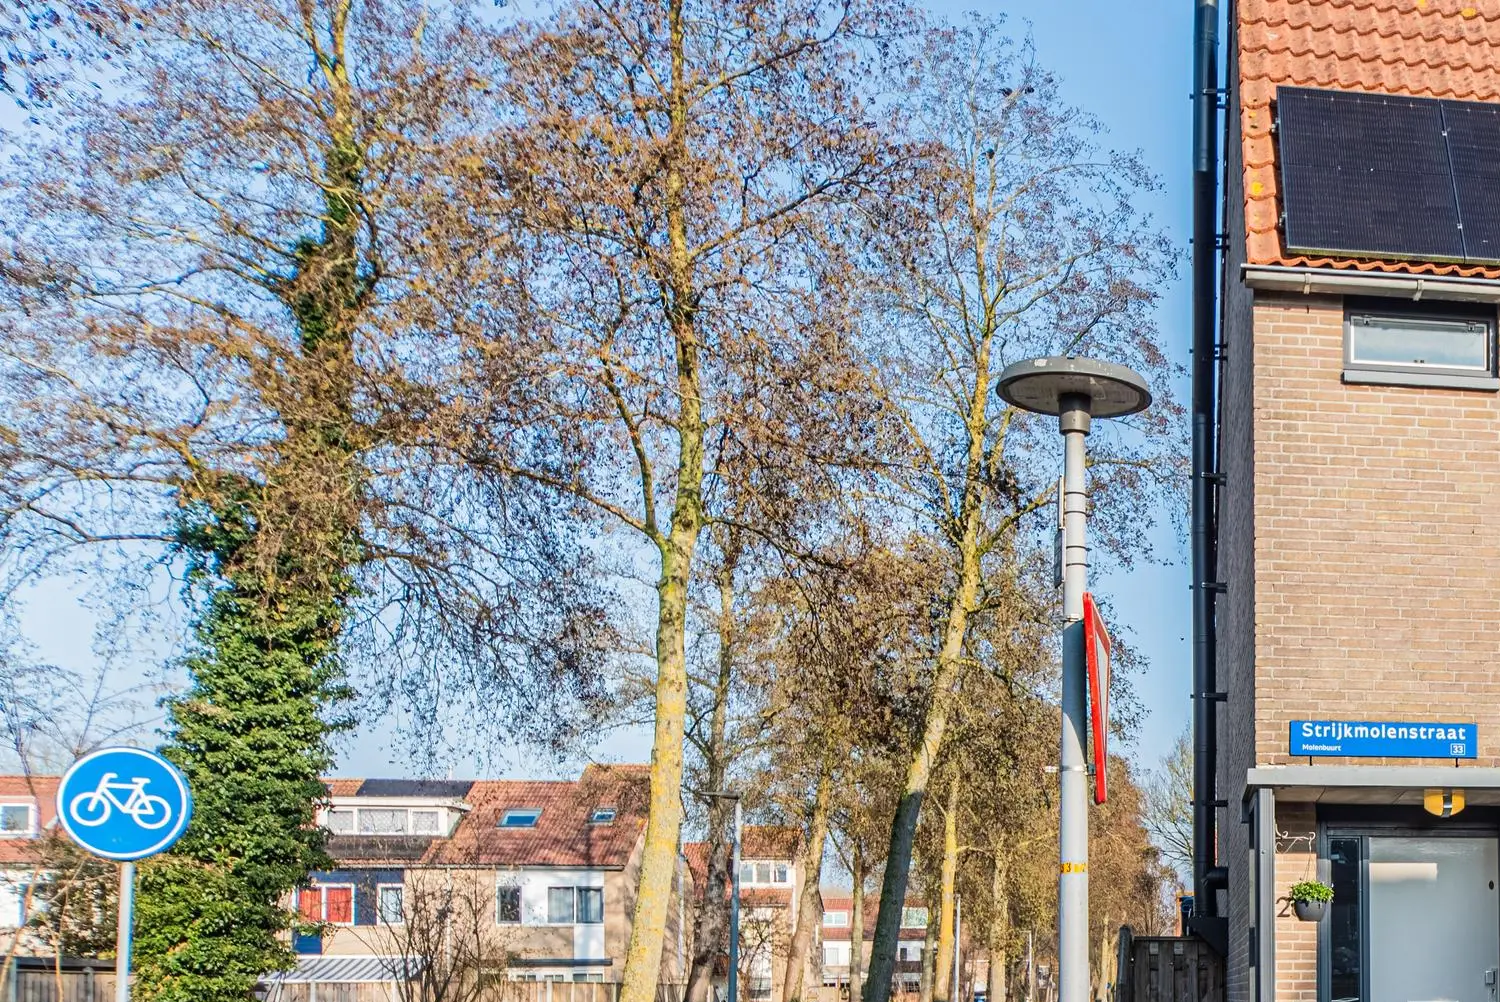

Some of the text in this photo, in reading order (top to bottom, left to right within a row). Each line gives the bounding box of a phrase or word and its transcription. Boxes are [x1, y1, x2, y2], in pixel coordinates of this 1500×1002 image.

[1302, 722, 1466, 740] Strijkmolenstraat
[1302, 743, 1342, 752] Molenbuurt
[1452, 745, 1464, 754] 33
